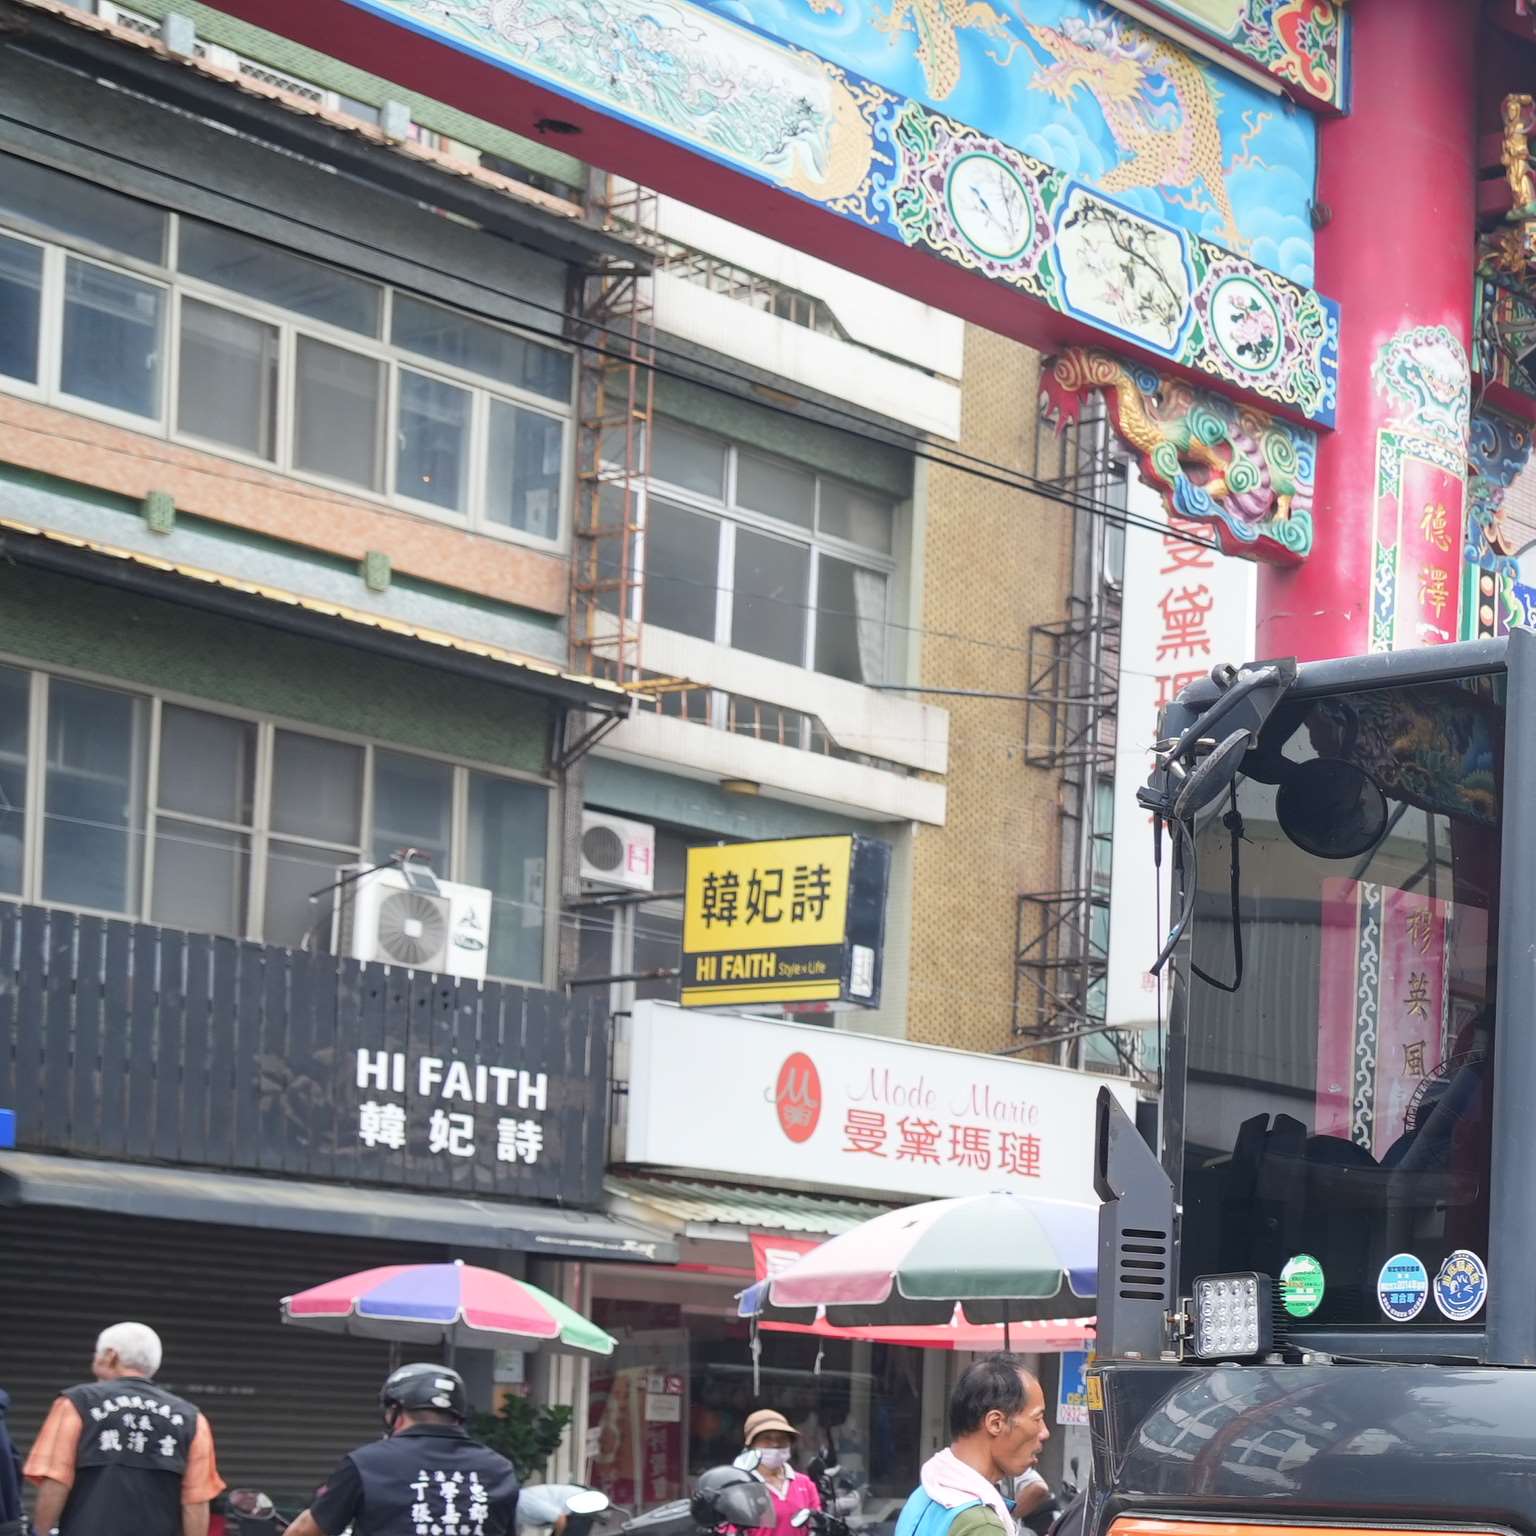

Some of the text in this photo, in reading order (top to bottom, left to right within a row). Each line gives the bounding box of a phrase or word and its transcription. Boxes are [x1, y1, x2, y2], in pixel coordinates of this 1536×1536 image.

[1418, 502, 1452, 652] 德澤
[700, 863, 832, 929] 韓妃詩
[695, 957, 717, 982] HI
[721, 953, 777, 979] FAITH
[356, 1048, 548, 1111] HI FAITH
[846, 1067, 1040, 1125] Mode Marie
[358, 1100, 544, 1164] 韓妃詩
[842, 1108, 1041, 1178] 曼黛瑪璉
